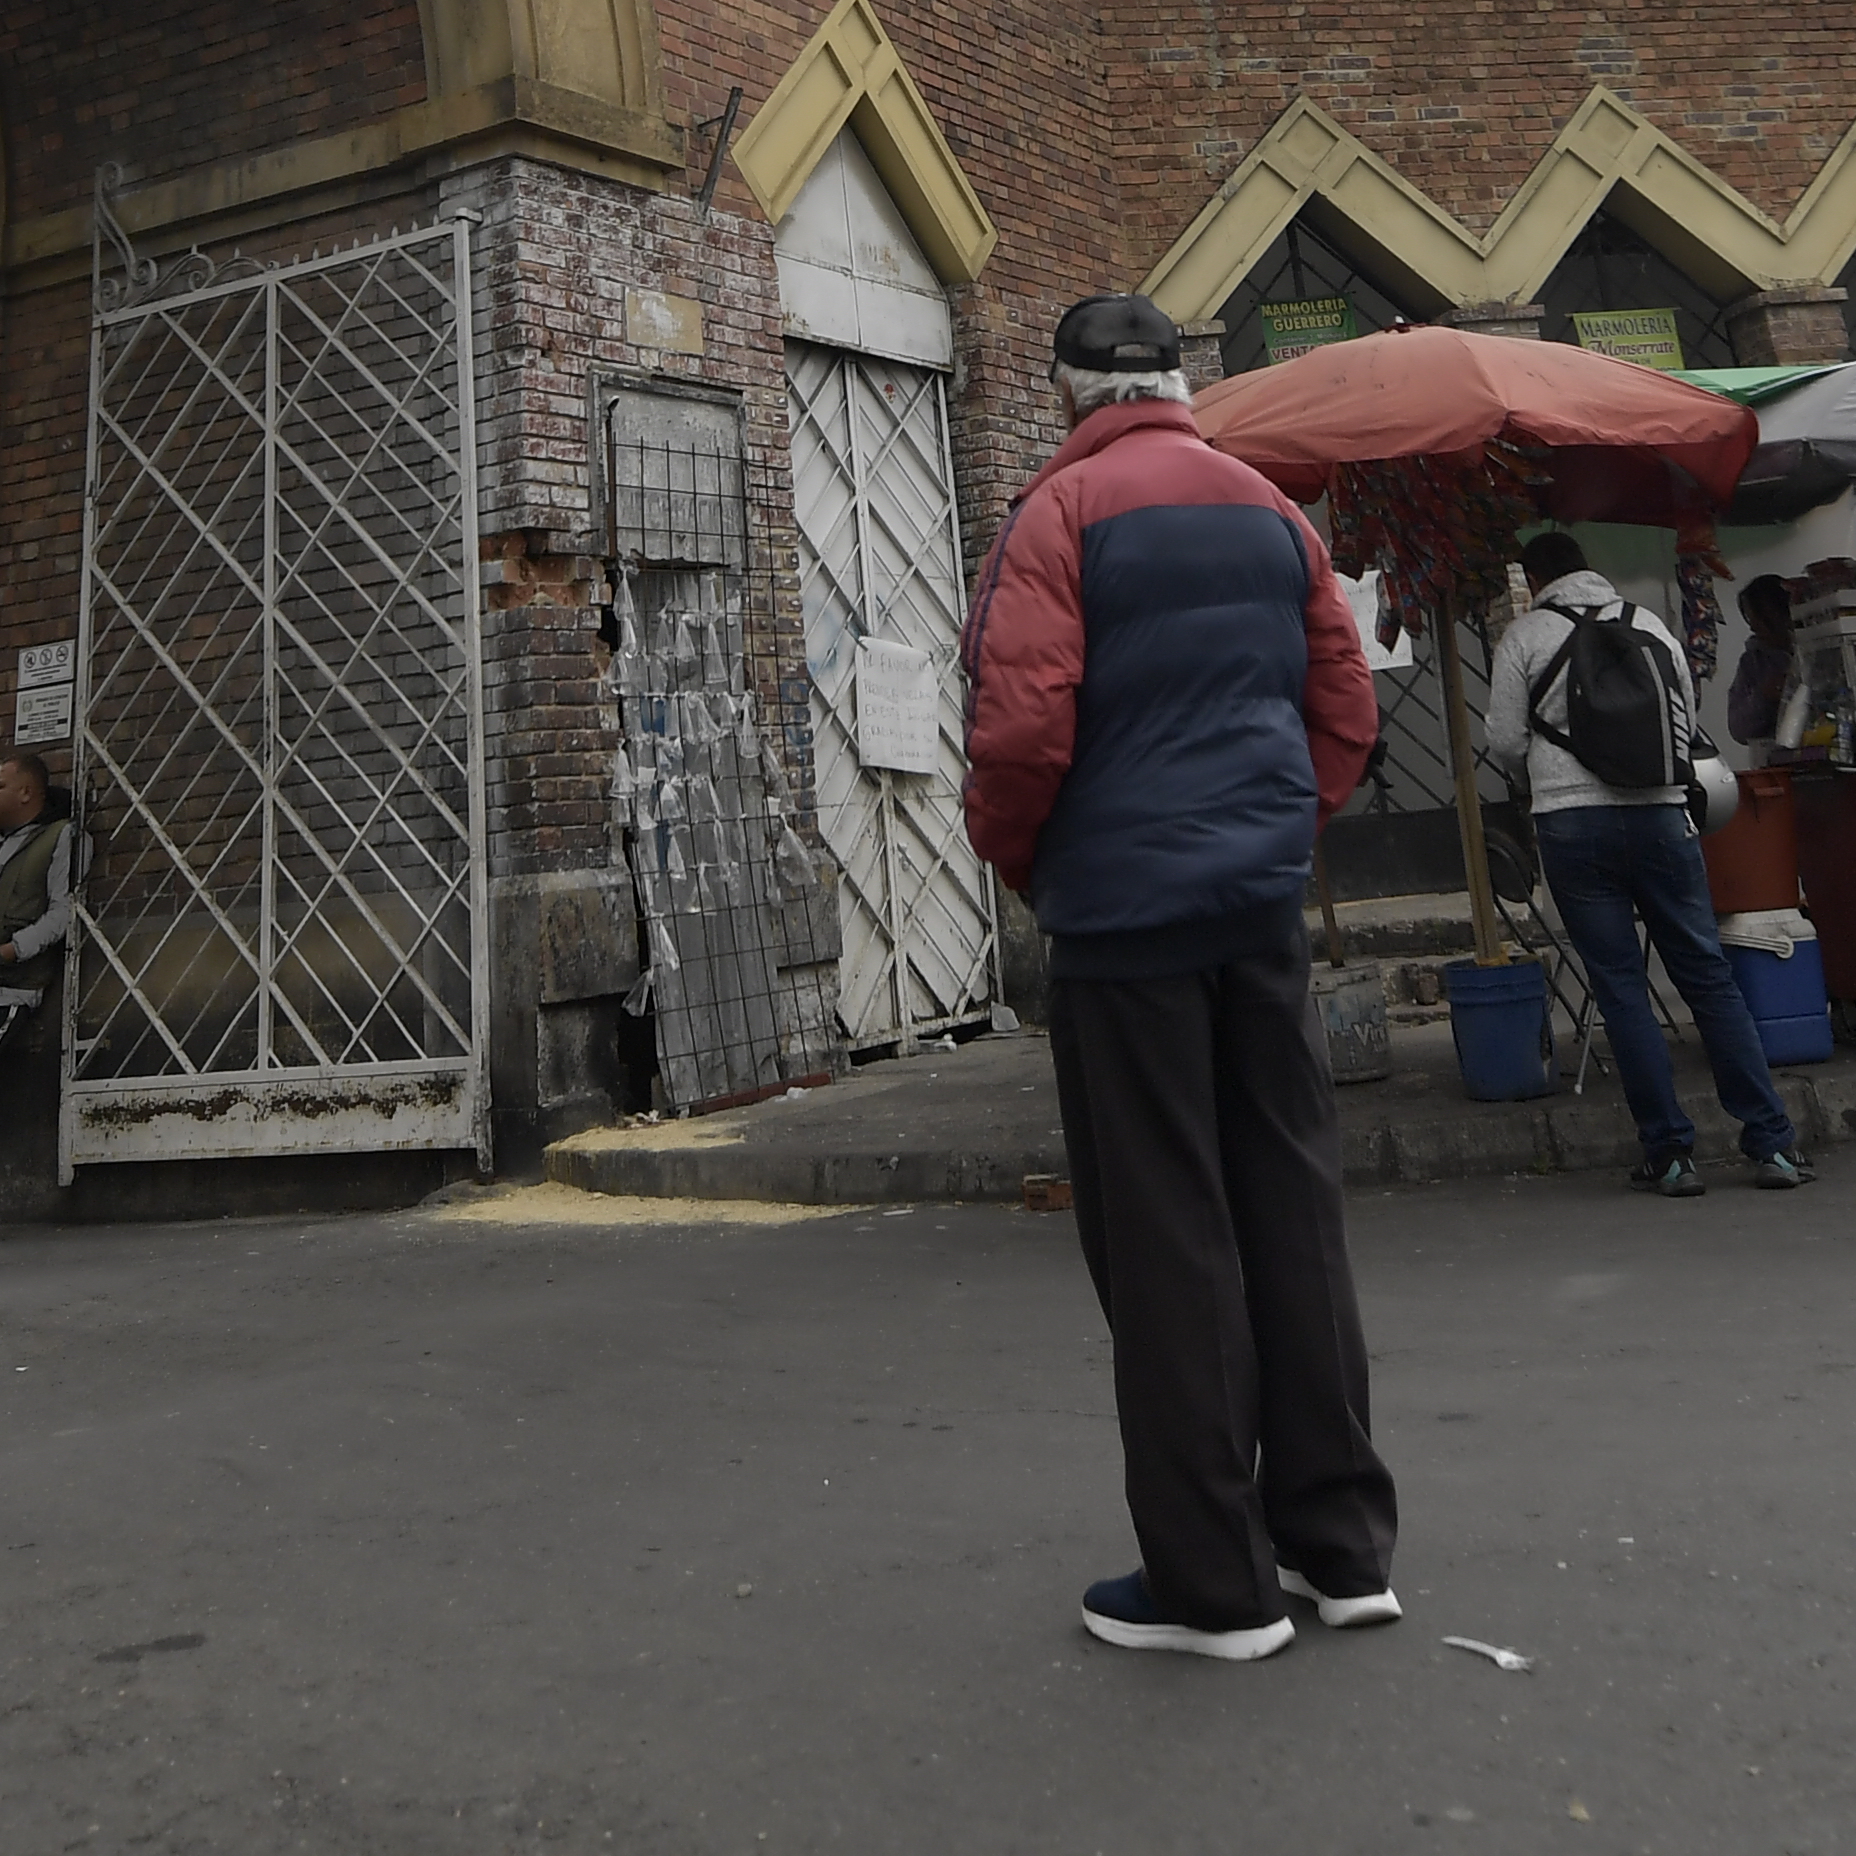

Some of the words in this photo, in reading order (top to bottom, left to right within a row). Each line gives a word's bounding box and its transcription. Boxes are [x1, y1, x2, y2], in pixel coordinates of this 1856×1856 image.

[1262, 298, 1347, 317] MARMOLERIA
[1273, 313, 1343, 332] GUERRERO
[1588, 339, 1675, 356] Monserrate
